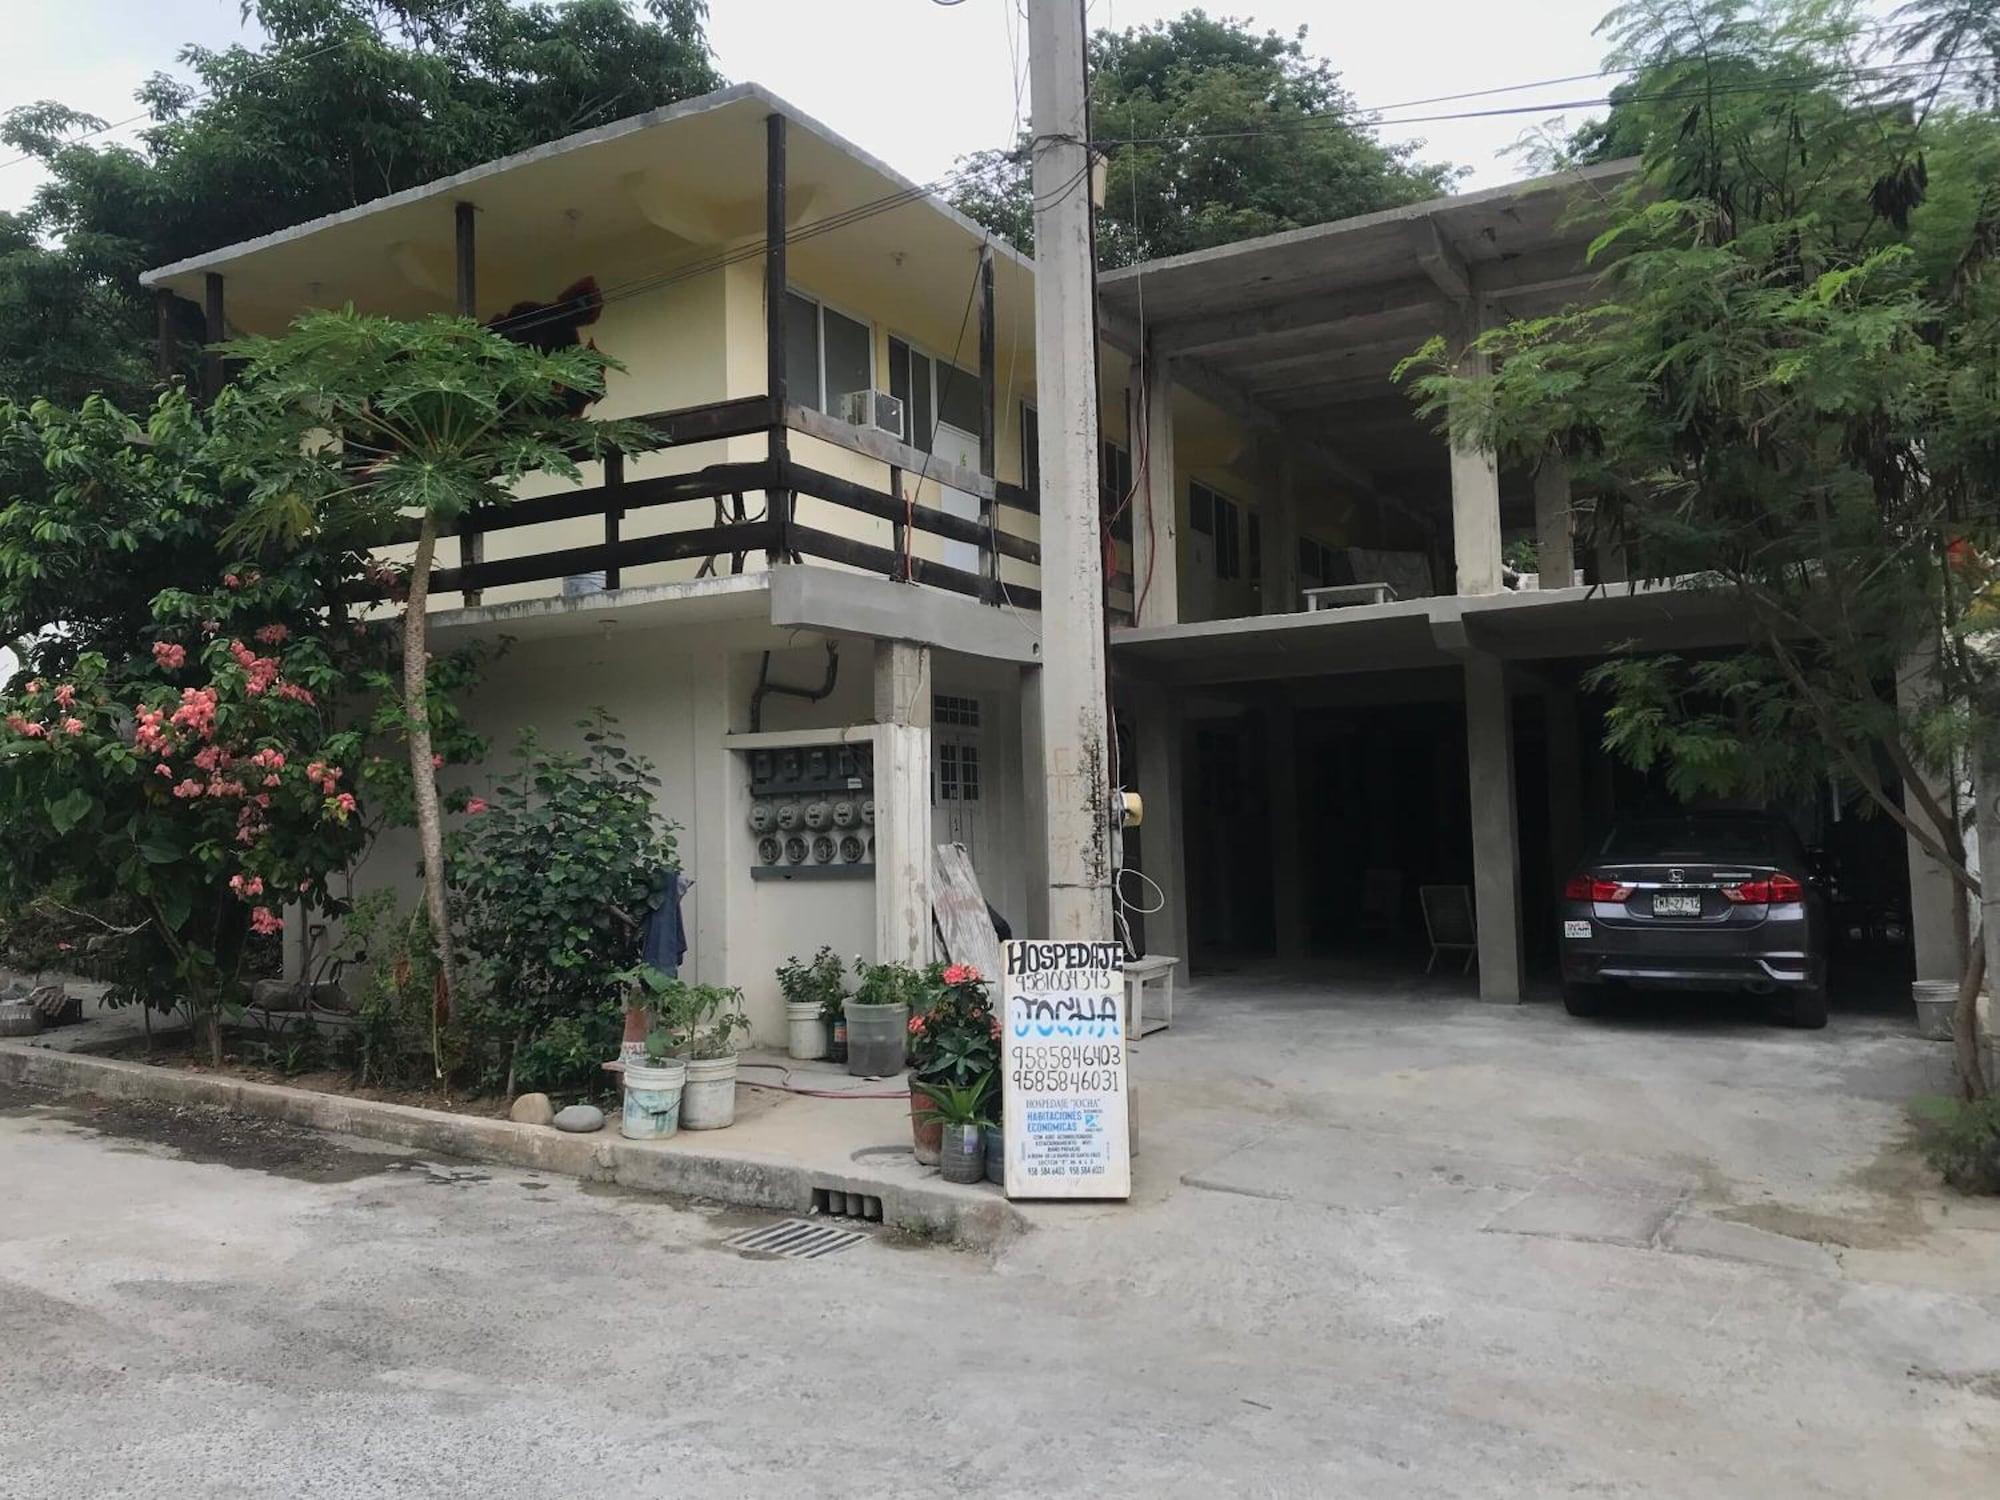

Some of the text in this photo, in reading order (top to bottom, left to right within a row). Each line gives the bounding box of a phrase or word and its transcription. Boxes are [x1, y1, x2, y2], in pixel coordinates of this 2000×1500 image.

[1007, 941, 1124, 975] HOSPEDAJE
[1016, 970, 1110, 992] 9581004343
[1012, 1045, 1121, 1070] 9585846403
[1012, 1070, 1119, 1093] 9585846031
[1027, 1111, 1082, 1121] HABITACIONES
[1027, 1122, 1077, 1132] ECONOMICAS
